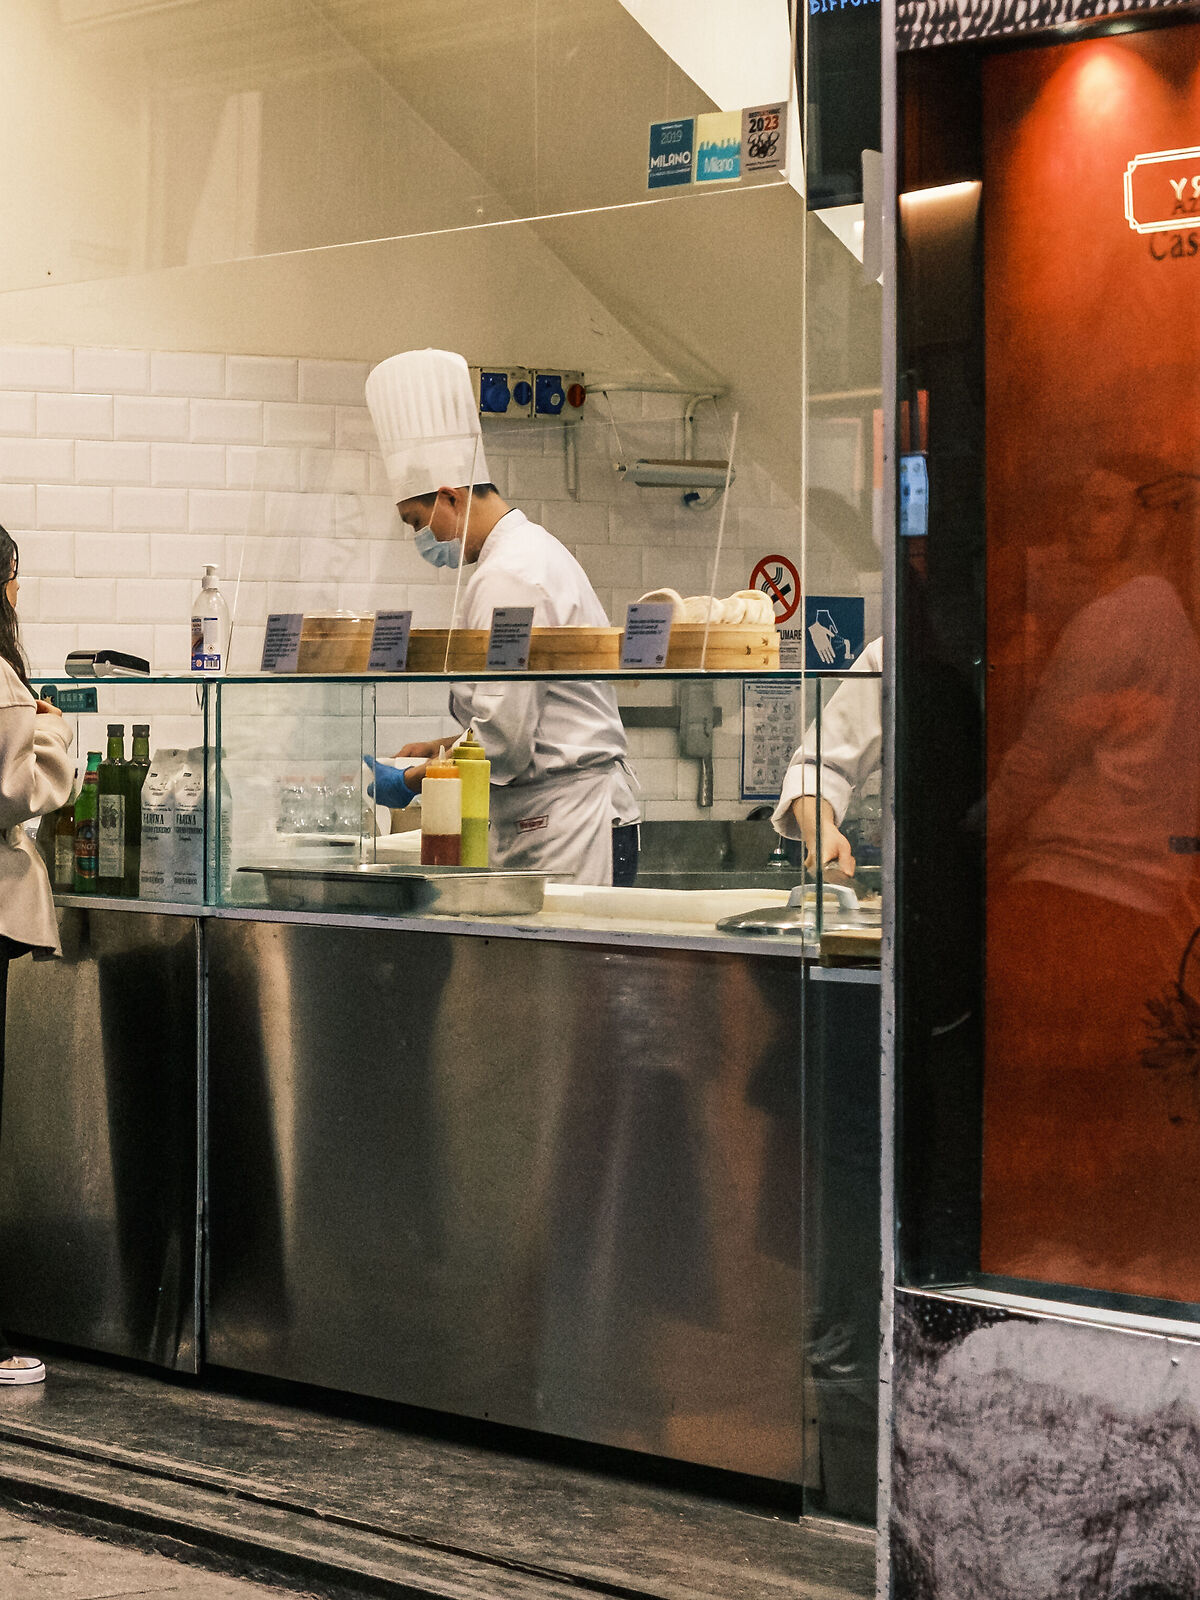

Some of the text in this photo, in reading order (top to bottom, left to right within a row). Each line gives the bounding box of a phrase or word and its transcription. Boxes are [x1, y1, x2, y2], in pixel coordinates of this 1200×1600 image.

[749, 115, 779, 133] 2023
[661, 128, 682, 145] 2019
[650, 151, 691, 169] MILANO
[776, 629, 802, 640] UMARE
